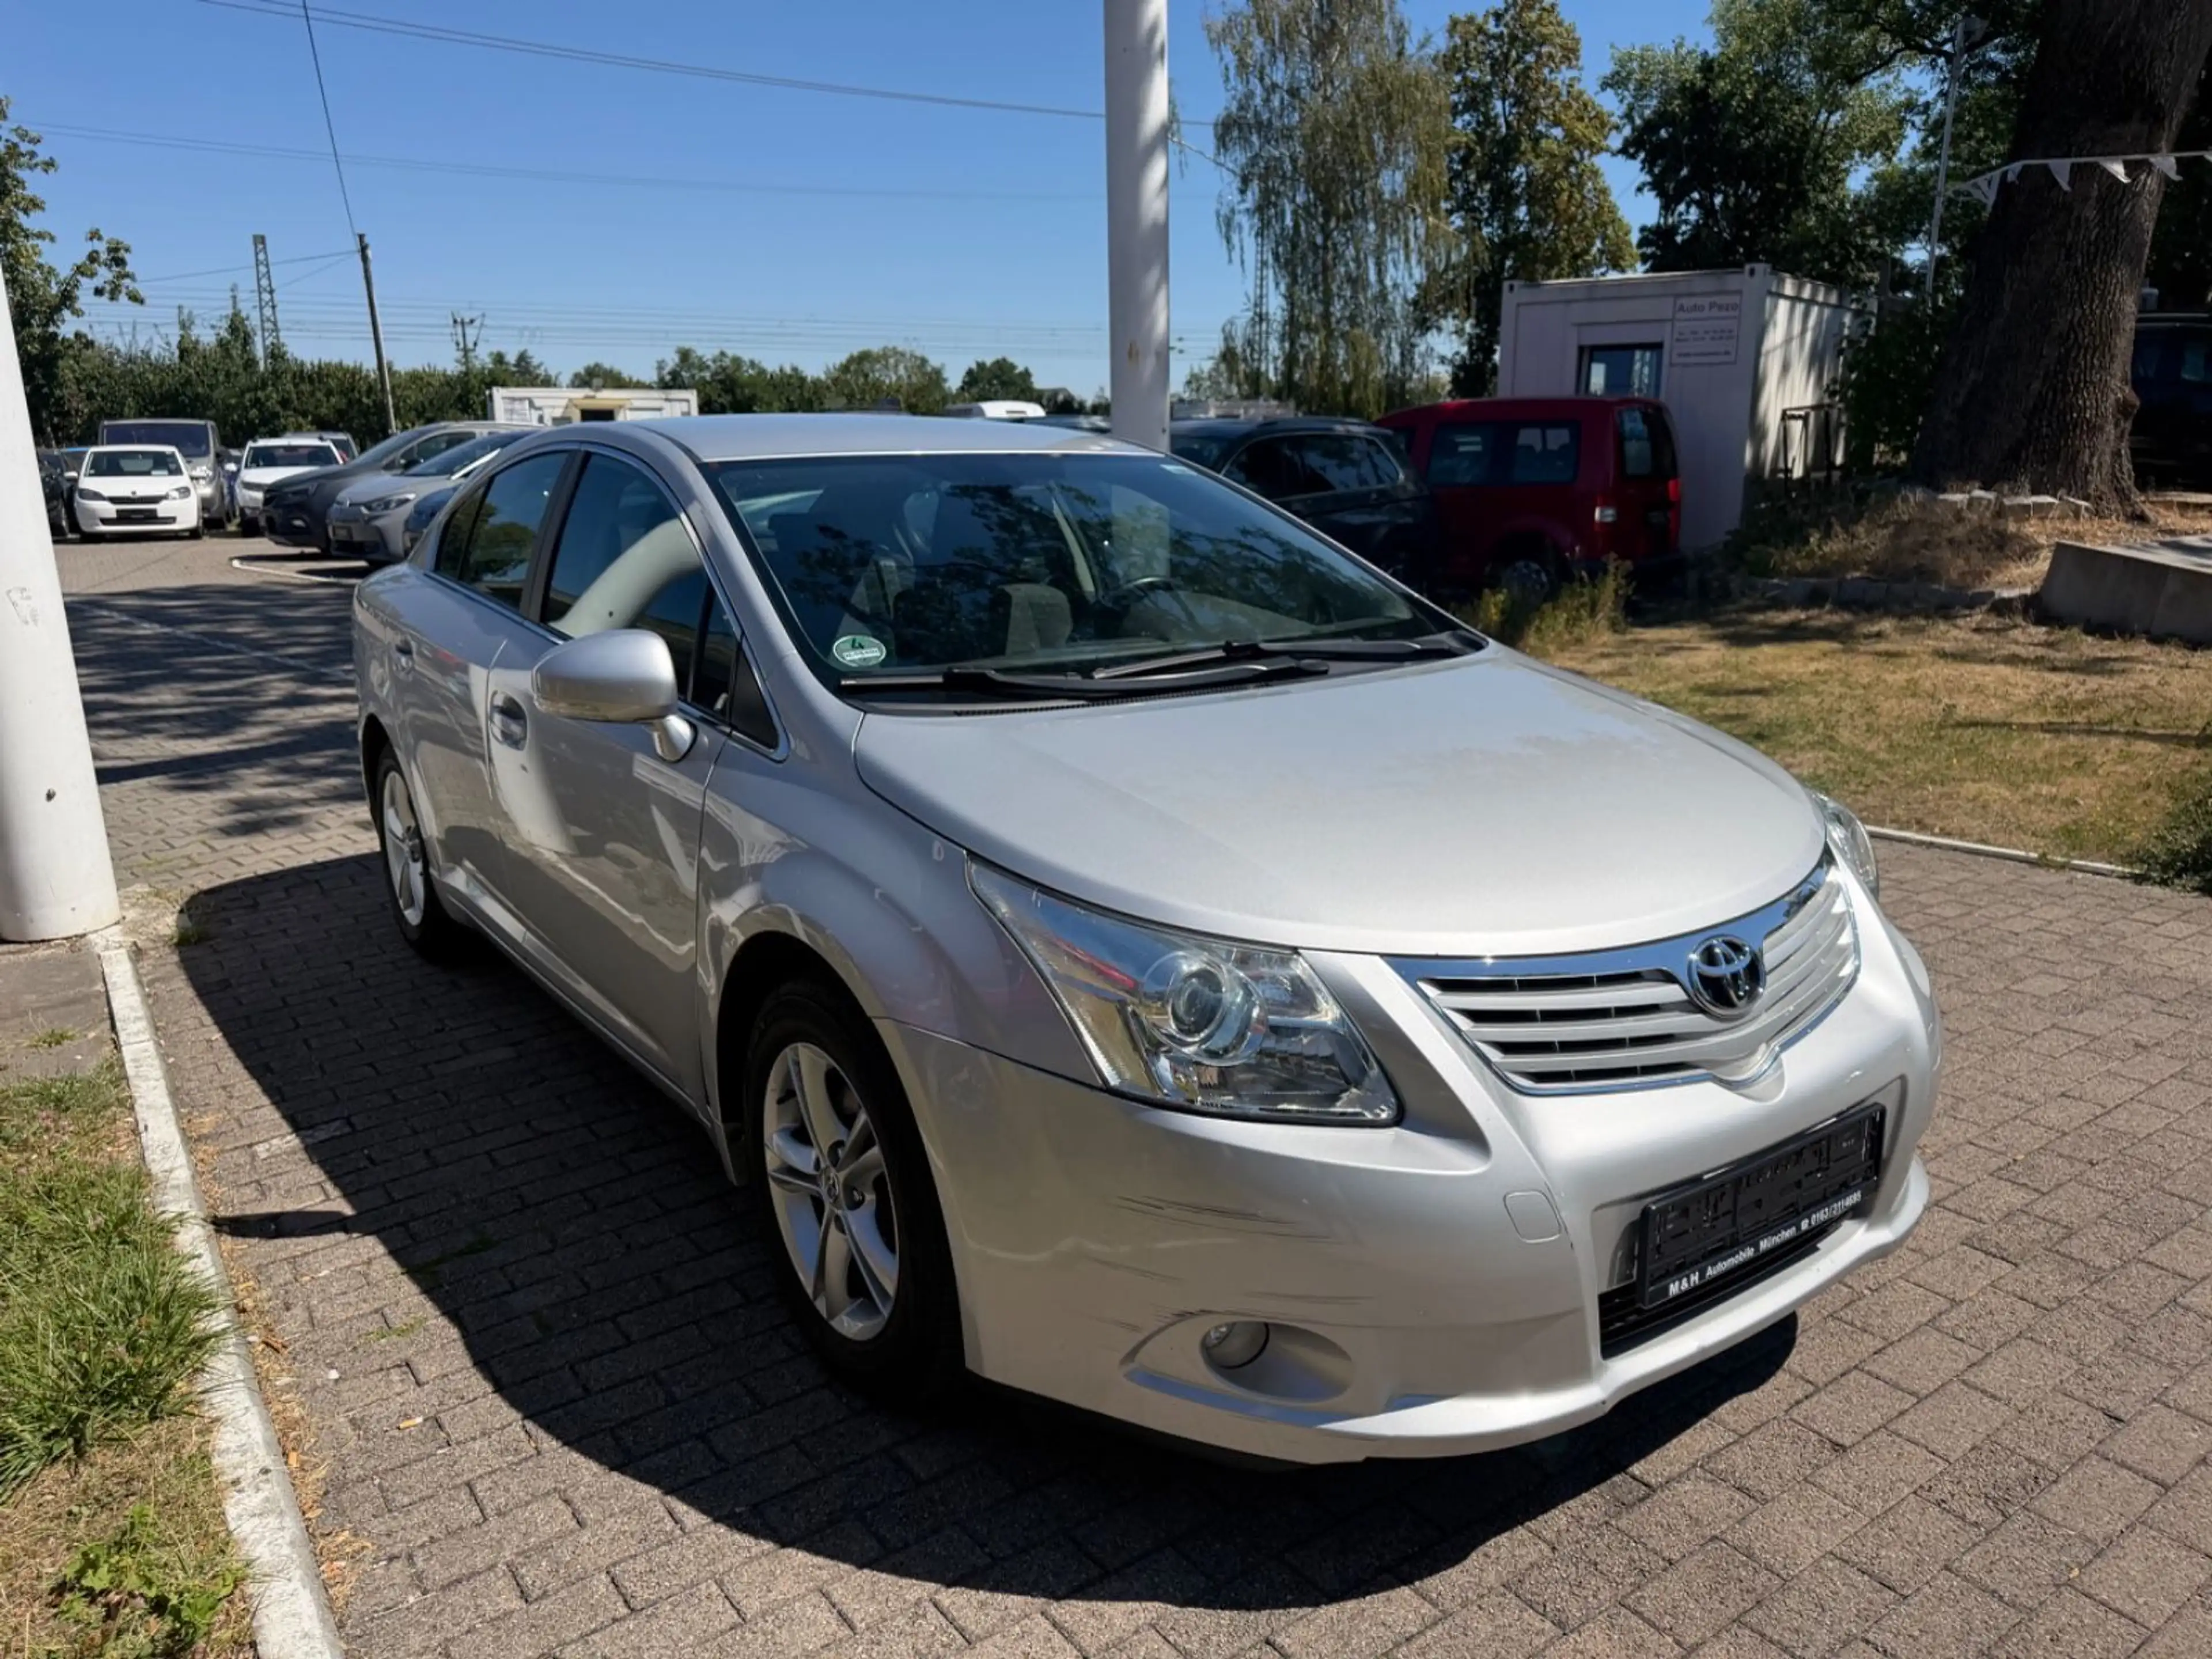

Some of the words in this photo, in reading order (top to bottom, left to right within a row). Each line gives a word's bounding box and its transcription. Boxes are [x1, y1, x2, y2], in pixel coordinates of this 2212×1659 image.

[1677, 302, 1706, 313] Auto
[851, 637, 865, 649] 4
[1706, 1246, 1755, 1280] Automobile
[1759, 1226, 1797, 1254] München
